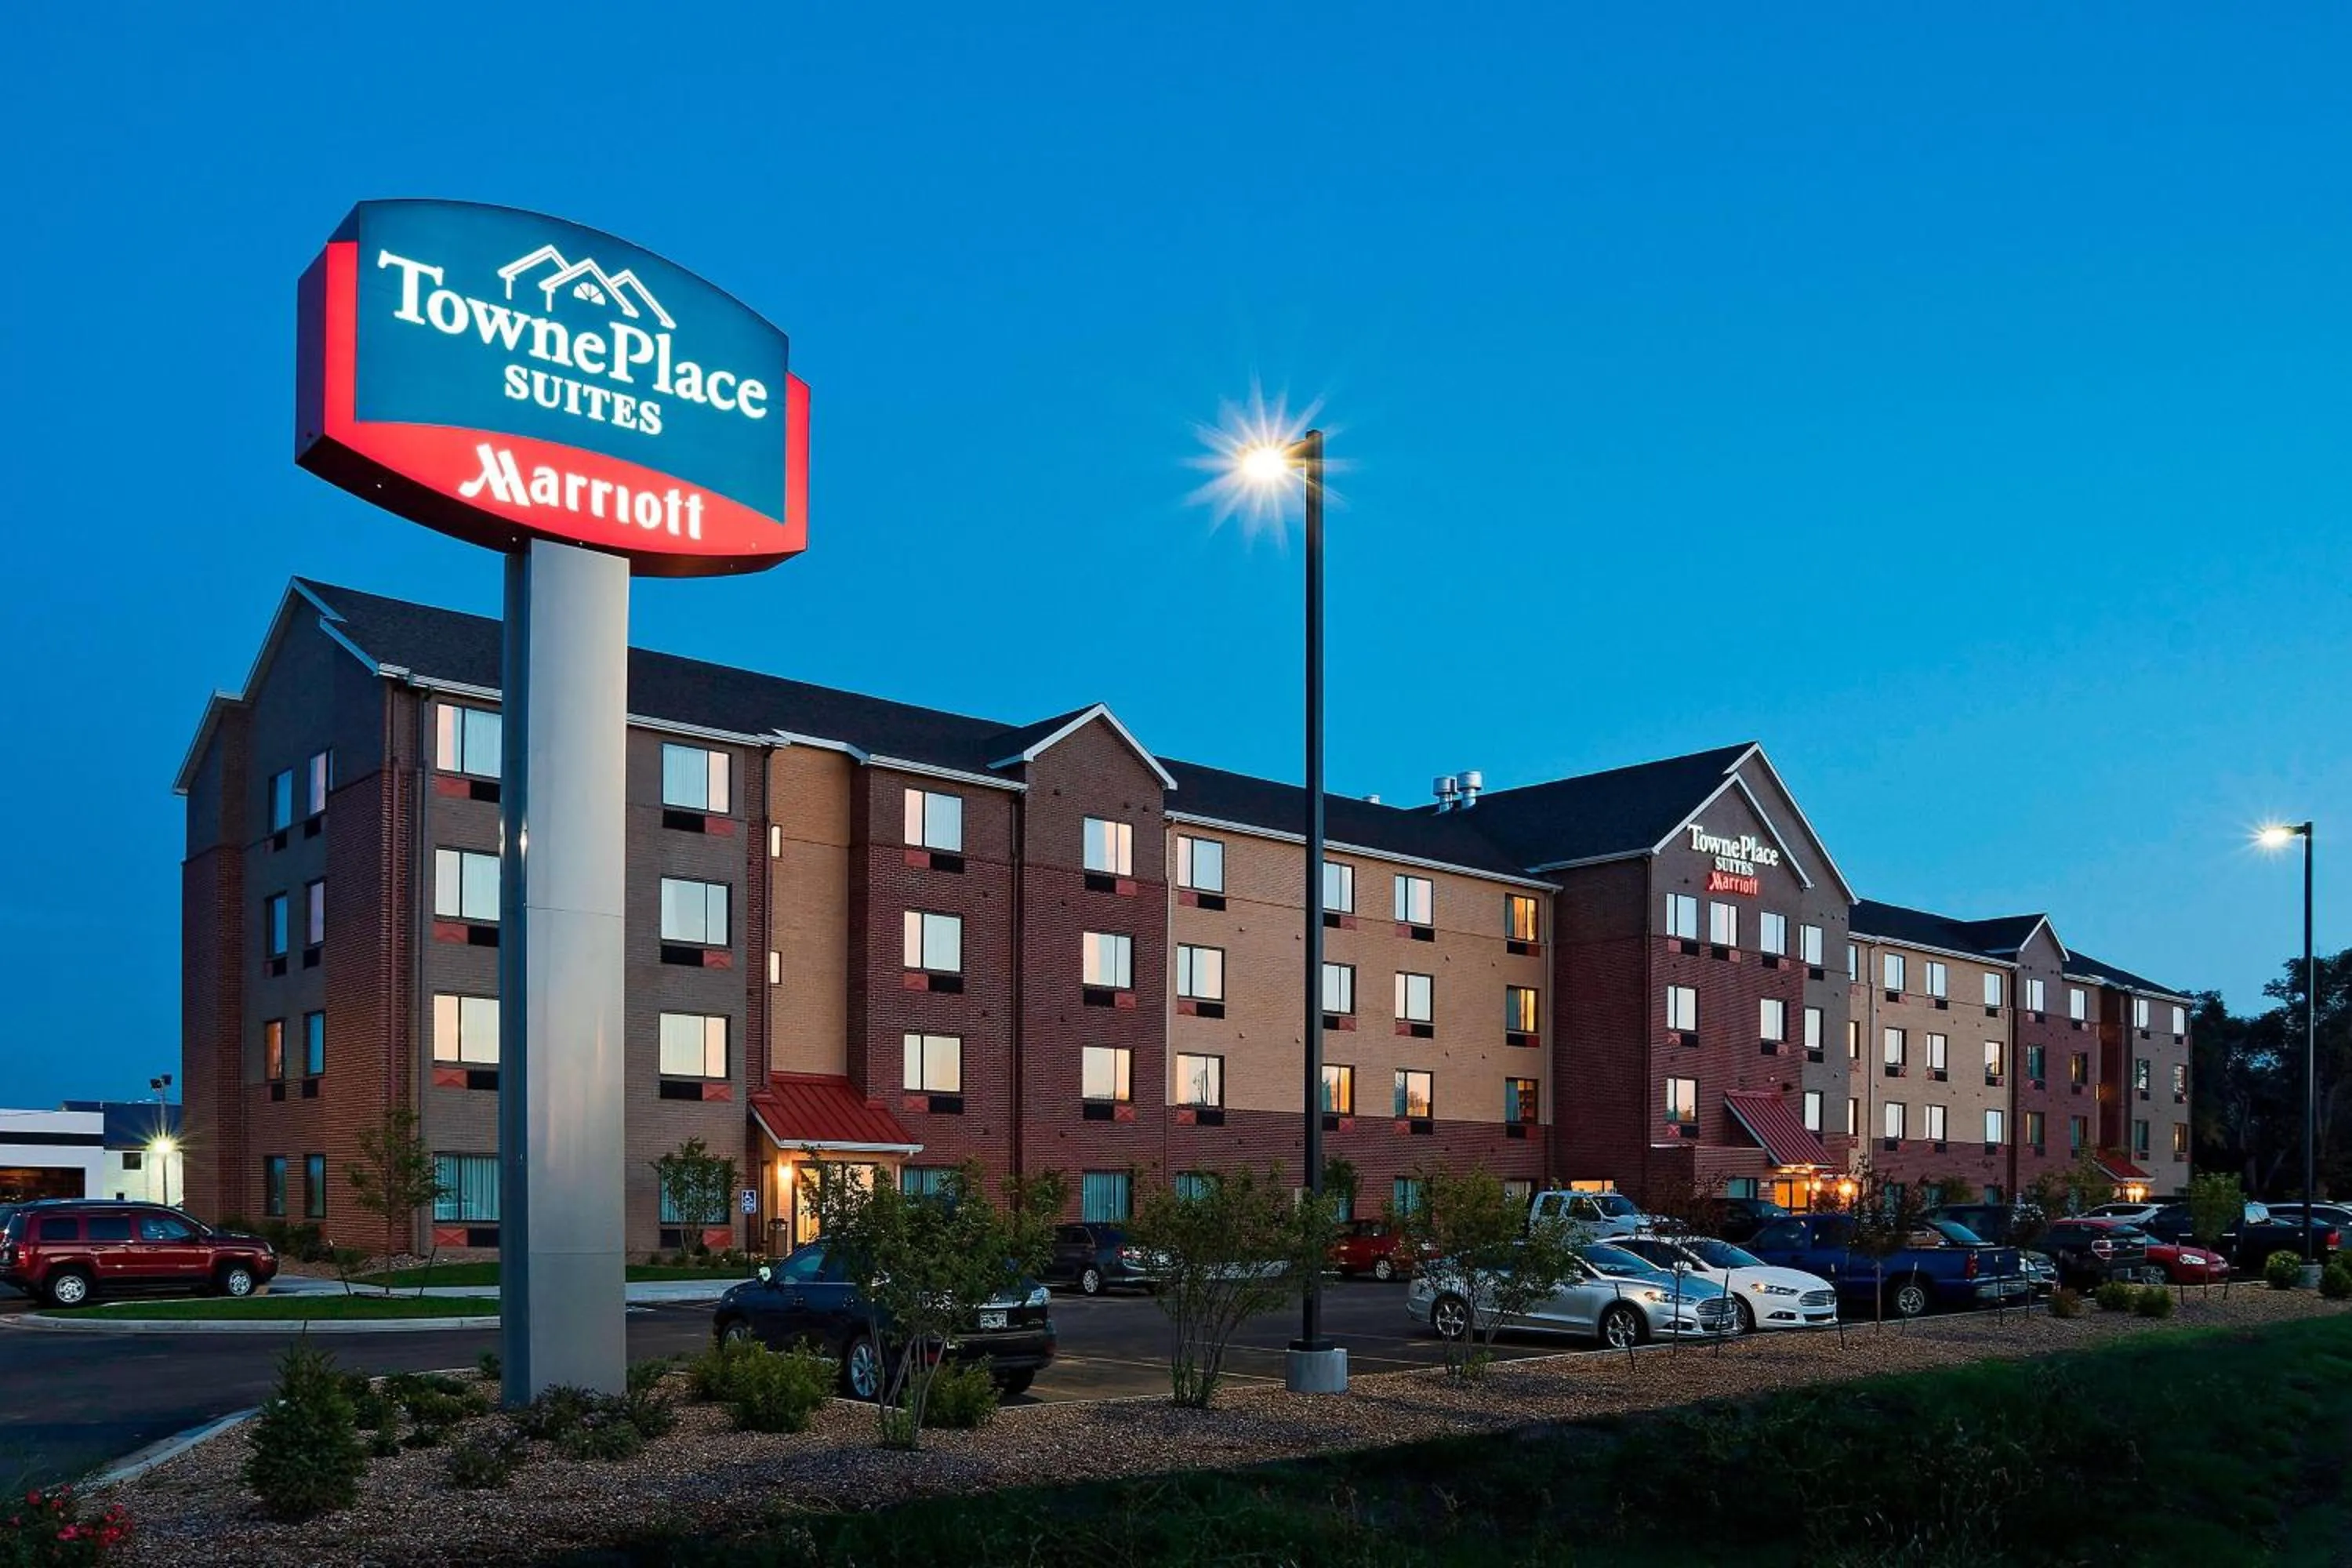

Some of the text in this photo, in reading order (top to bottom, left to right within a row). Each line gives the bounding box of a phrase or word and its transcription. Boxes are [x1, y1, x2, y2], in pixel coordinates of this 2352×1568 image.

[377, 249, 768, 419] TownePlace
[504, 364, 662, 436] SUITES
[458, 443, 706, 540] Marriott
[1686, 824, 1779, 866] TownePlace
[1714, 856, 1754, 875] SUITES
[1708, 872, 1758, 895] Marriott
